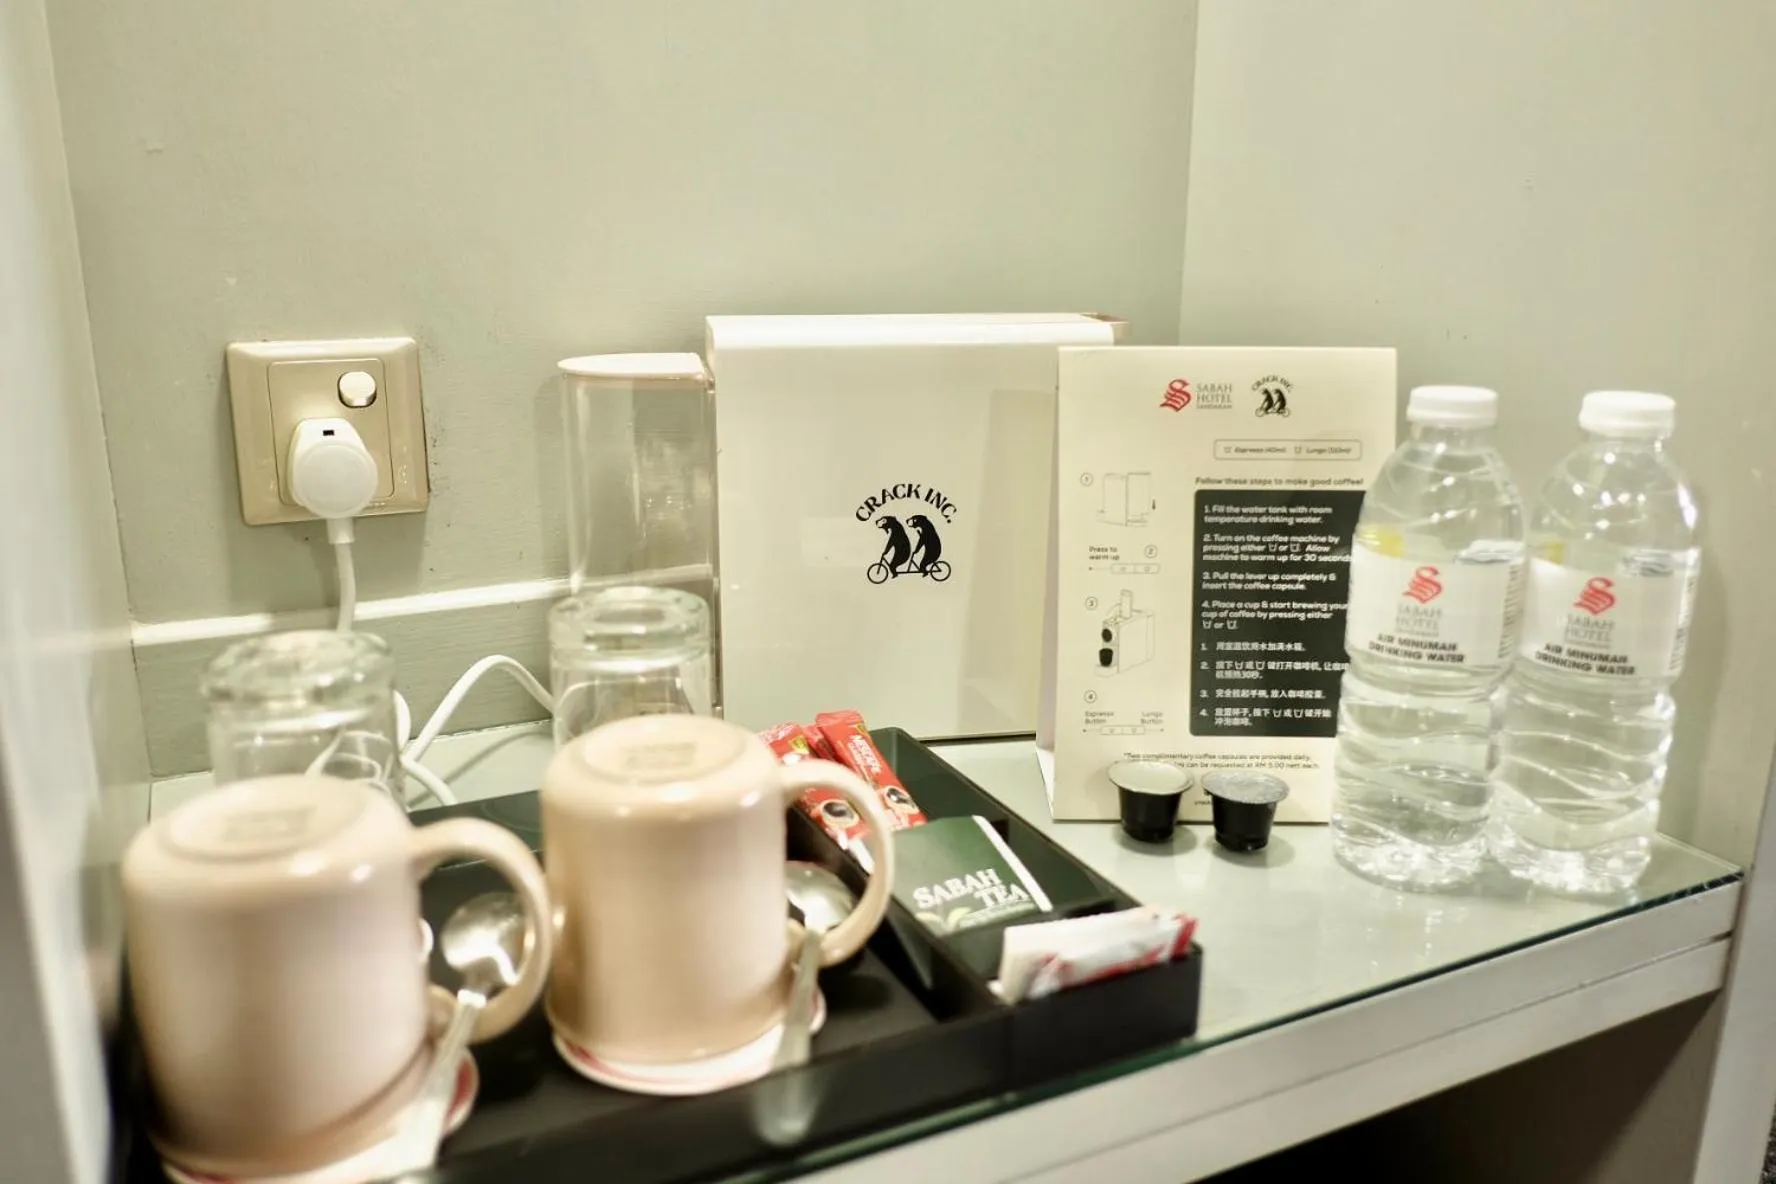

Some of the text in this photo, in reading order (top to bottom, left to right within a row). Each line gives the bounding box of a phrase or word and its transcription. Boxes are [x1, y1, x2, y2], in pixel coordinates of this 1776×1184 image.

[1196, 383, 1233, 393] SABAH
[1251, 375, 1279, 392] CRACK
[1196, 394, 1233, 403] HOTEL
[1195, 477, 1223, 485] Follow
[1225, 477, 1247, 485] these
[1250, 478, 1272, 487] steps
[1285, 477, 1308, 485] make
[1310, 478, 1331, 487] good
[1333, 477, 1364, 485] coffee!
[855, 483, 957, 524] CRACK INC.
[1204, 505, 1211, 514] 1.
[1212, 505, 1224, 514] Fill
[1226, 505, 1240, 514] the
[1241, 506, 1267, 514] water
[1268, 505, 1287, 514] tank
[1289, 506, 1308, 514] with
[1204, 515, 1258, 524] temperature
[1259, 515, 1294, 525] drinking
[1203, 533, 1211, 542] 2.
[1213, 533, 1233, 542] Turn
[1246, 533, 1261, 542] the
[1262, 534, 1288, 543] coffee
[1290, 534, 1327, 543] machine
[1328, 534, 1340, 544] by
[1202, 544, 1239, 553] pressing
[1240, 544, 1266, 552] either
[1305, 544, 1330, 552] Allow
[1276, 555, 1289, 563] up
[1290, 554, 1302, 562] for
[1202, 572, 1210, 580] 3.
[1212, 572, 1229, 580] Pull
[1230, 572, 1245, 580] the
[1245, 572, 1267, 580] lever
[1267, 574, 1280, 582] up
[1280, 573, 1328, 583] completely
[1202, 582, 1227, 590] insert
[1228, 582, 1243, 590] the
[1201, 601, 1210, 609] 4.
[1212, 601, 1236, 609] Place
[1244, 603, 1260, 611] cup
[1269, 602, 1291, 610] start
[1292, 601, 1327, 612] brewing
[1328, 603, 1348, 612] your
[1201, 611, 1334, 621] cup of coffee by pressing either
[1200, 643, 1208, 651] 1.
[1378, 633, 1395, 643] AIR
[1398, 637, 1458, 652] MINUMAN
[1369, 641, 1466, 663] DRINKING WATER
[1544, 643, 1563, 654] AIR
[1566, 648, 1629, 664] MINUMAN
[1200, 661, 1209, 670] 2.
[1535, 650, 1636, 676] DRINKING WATER
[1199, 689, 1209, 698] 3.
[1199, 708, 1209, 717] 4.
[912, 867, 1003, 909] SABAH
[974, 883, 1031, 909] TEA
